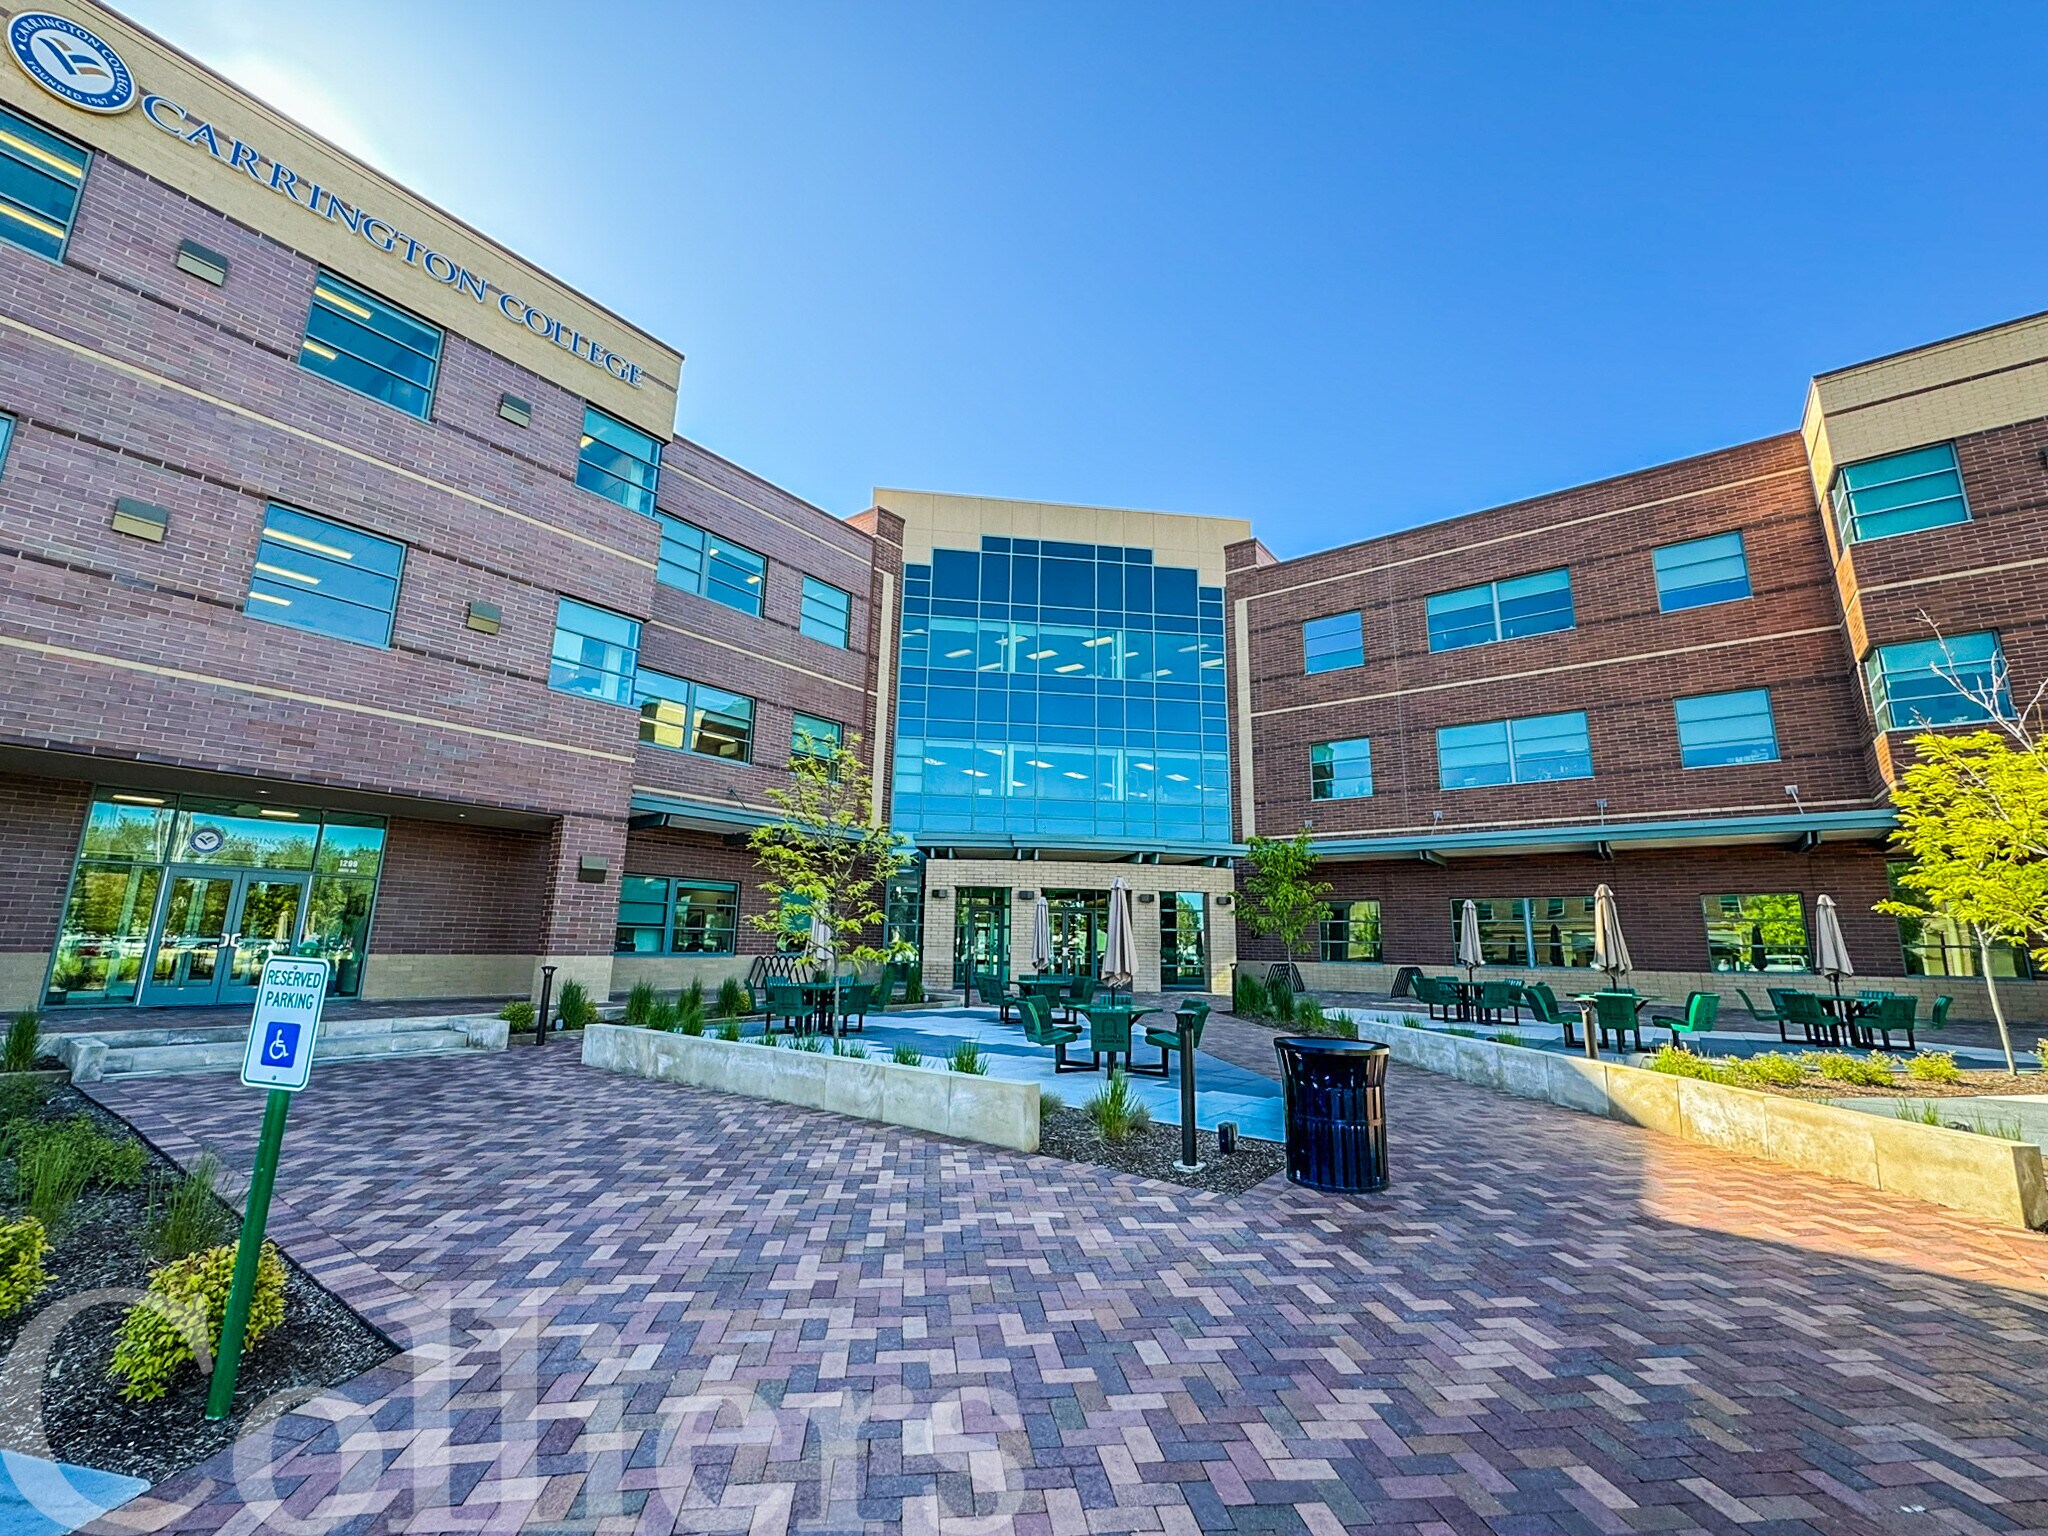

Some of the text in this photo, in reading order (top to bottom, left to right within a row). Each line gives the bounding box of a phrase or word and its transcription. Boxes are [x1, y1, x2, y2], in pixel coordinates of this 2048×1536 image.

[15, 17, 129, 97] CARRINGTON COLLEGE
[27, 60, 82, 100] FOUNDED
[141, 93, 646, 389] CARRINGTON COLLEGE
[266, 969, 321, 989] RESERVED
[264, 991, 315, 1010] PARKING
